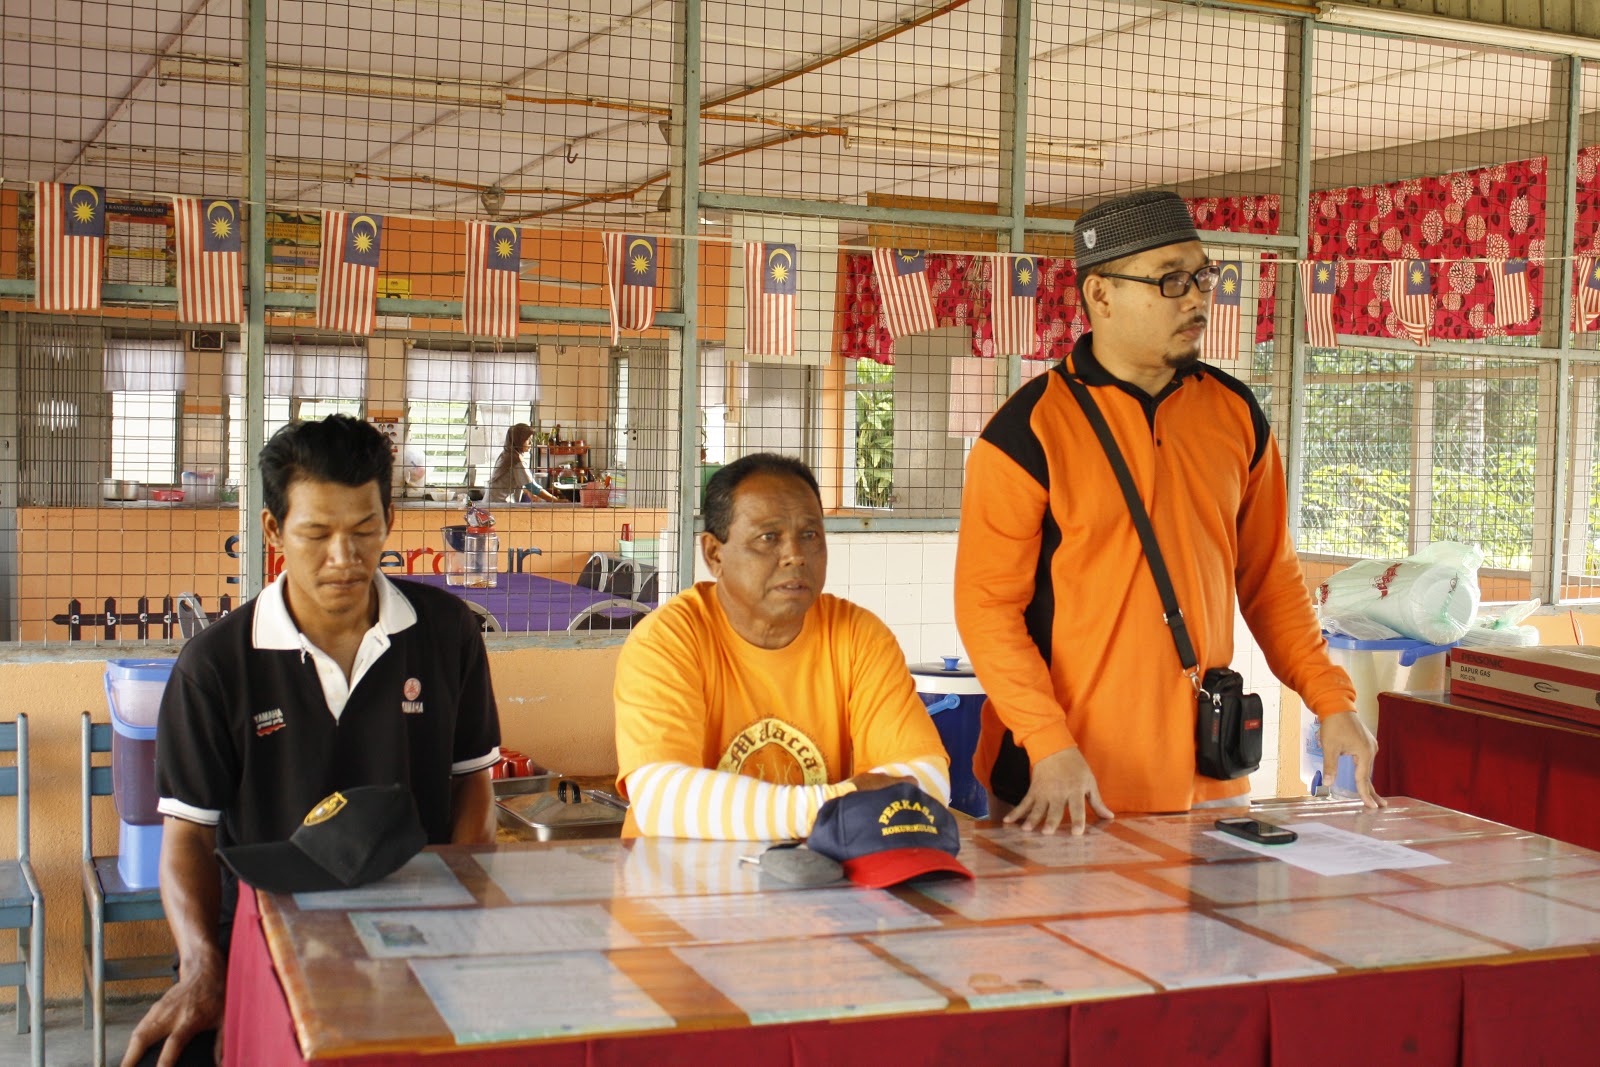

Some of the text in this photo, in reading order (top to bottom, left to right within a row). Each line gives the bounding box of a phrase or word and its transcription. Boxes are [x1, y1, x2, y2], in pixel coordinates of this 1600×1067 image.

[1461, 652, 1505, 668] PENSONIC
[1460, 665, 1491, 678] DAPUR GAS
[253, 708, 284, 724] YAMAHA
[878, 799, 935, 825] PERKASA
